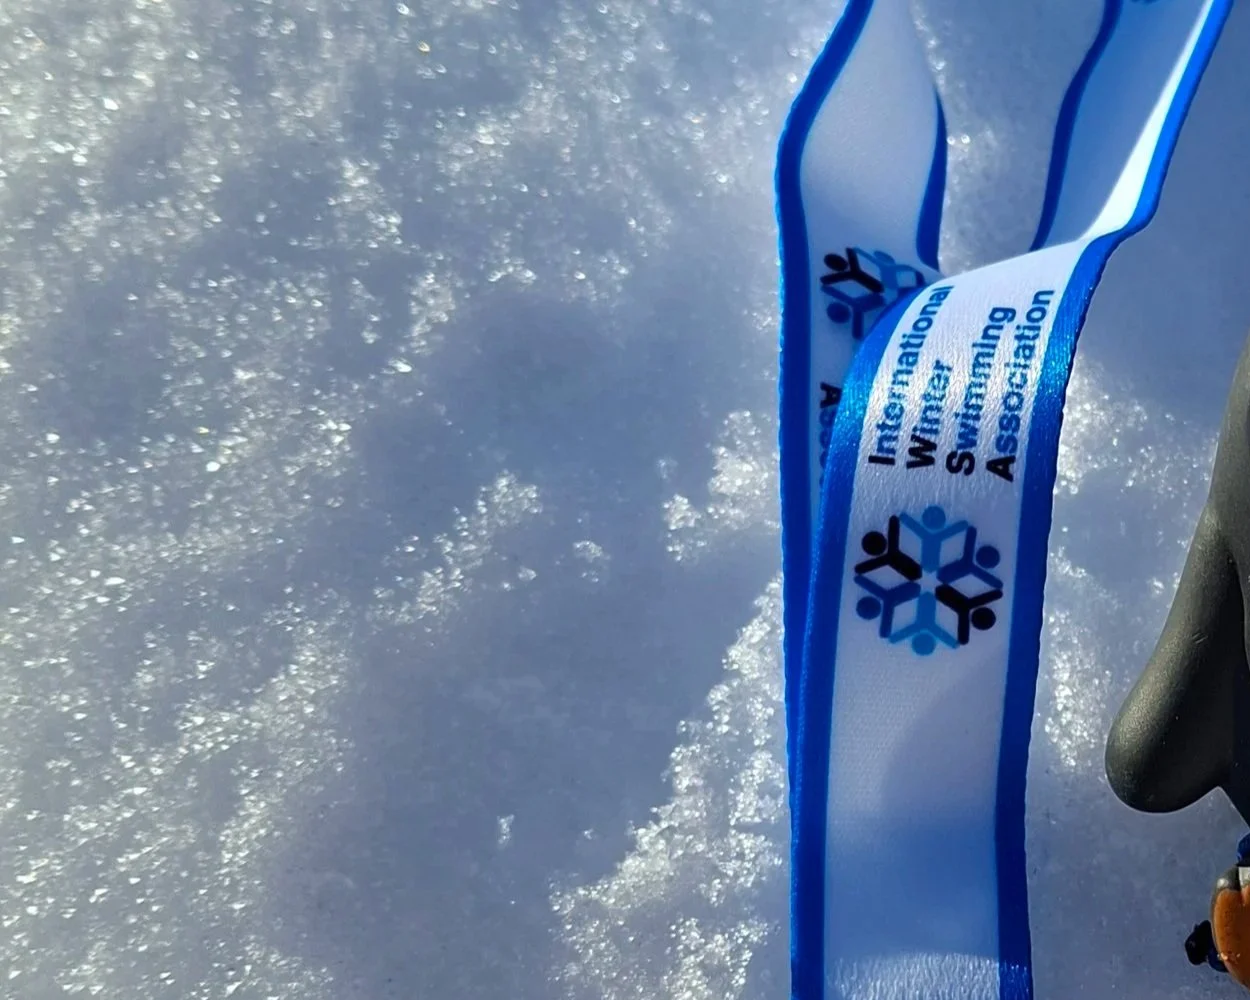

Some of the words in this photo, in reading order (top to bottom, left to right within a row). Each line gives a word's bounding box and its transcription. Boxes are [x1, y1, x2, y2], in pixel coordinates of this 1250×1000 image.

[868, 284, 955, 466] International
[906, 360, 952, 469] Winter
[946, 306, 1017, 476] Swimming
[986, 289, 1055, 482] Association
